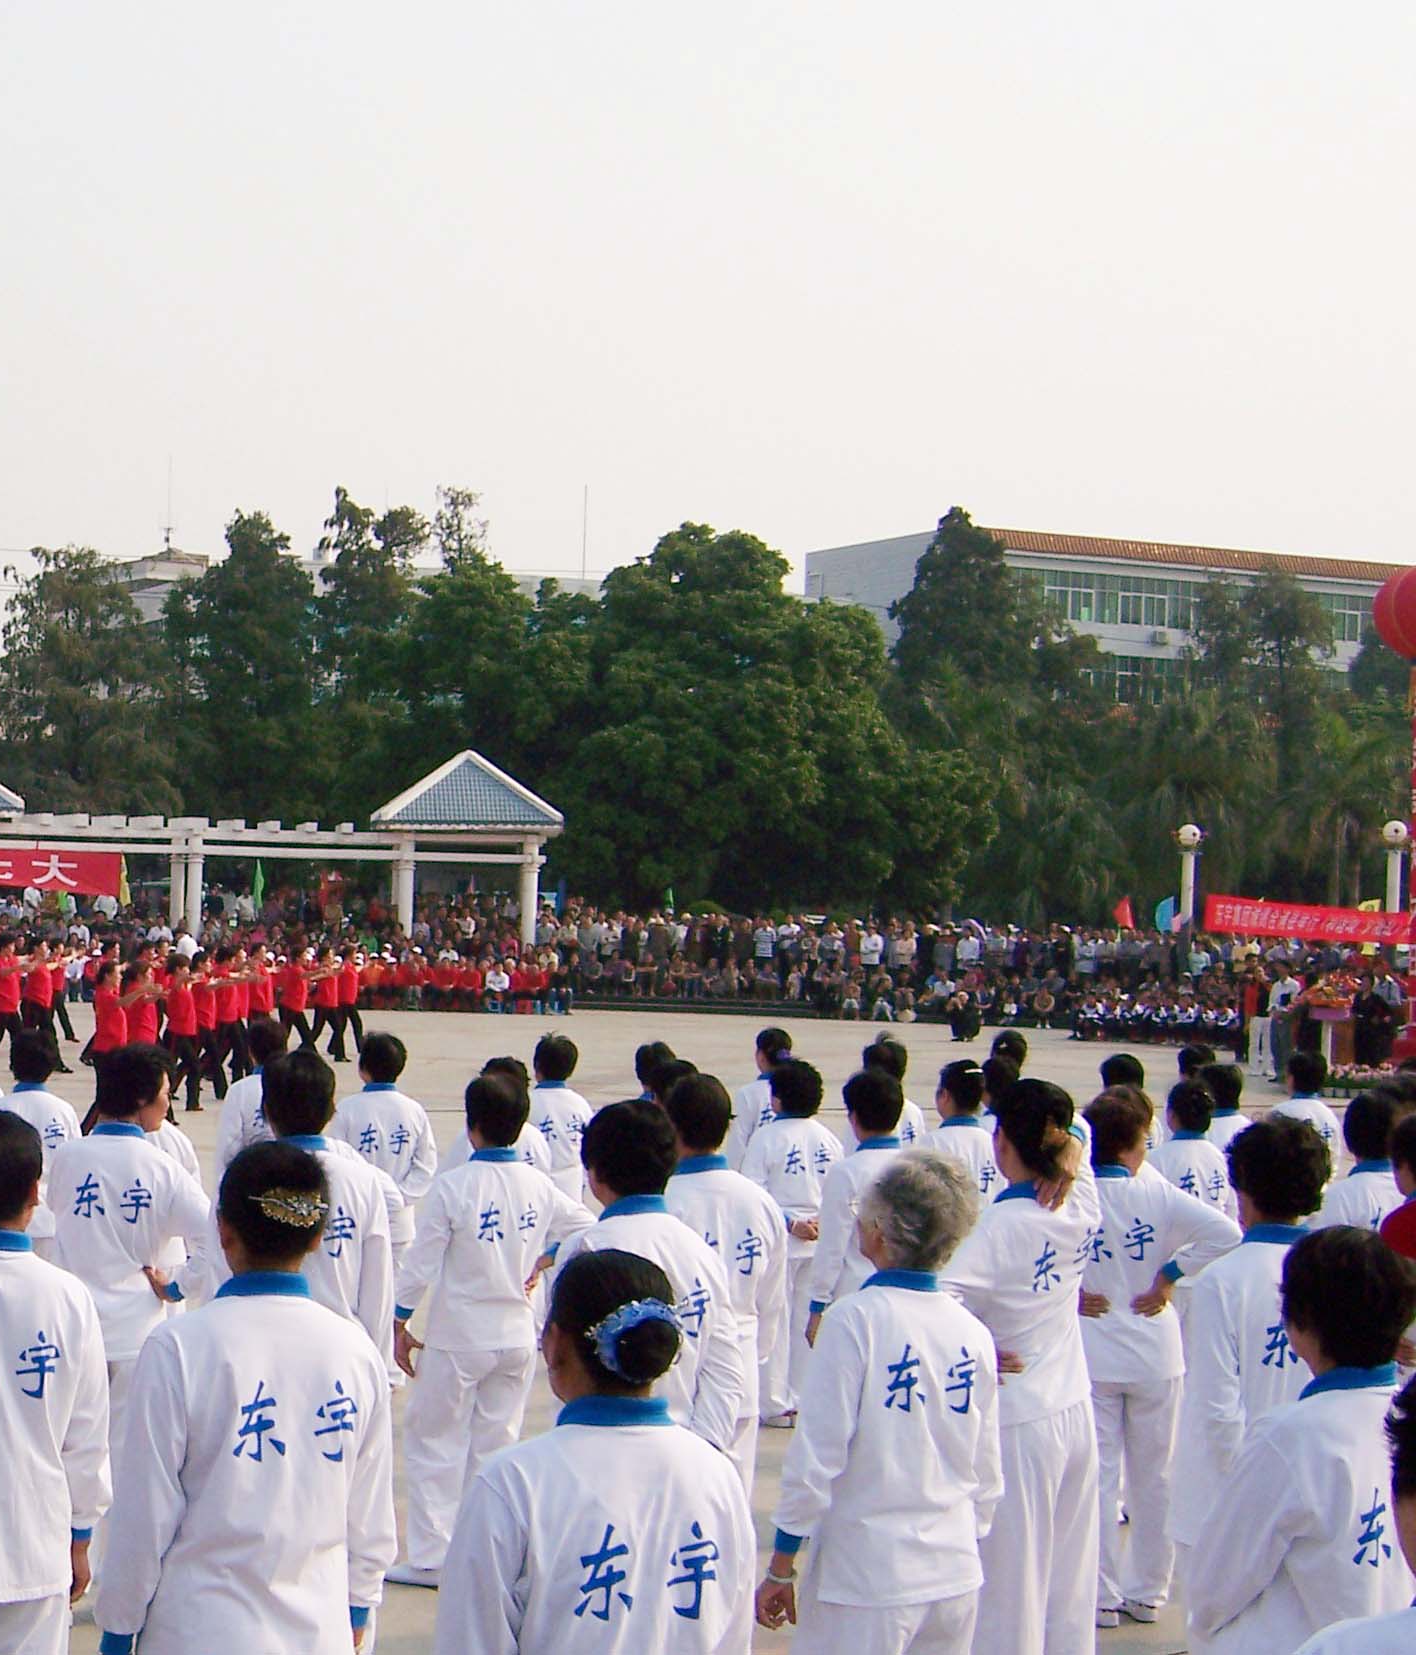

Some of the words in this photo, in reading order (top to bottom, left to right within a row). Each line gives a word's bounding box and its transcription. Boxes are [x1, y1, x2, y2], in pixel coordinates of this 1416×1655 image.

[44, 1118, 64, 1149] 宇
[359, 1123, 411, 1154] 东宇
[784, 1144, 832, 1175] 东宇
[73, 1172, 153, 1225] 东宇
[979, 1160, 996, 1194] 宇
[1179, 1167, 1225, 1201] 东宇
[323, 1206, 356, 1259] 宇
[477, 1201, 538, 1242] 东宇
[680, 1277, 711, 1339] 宇
[884, 1343, 977, 1415] 东宇
[232, 1380, 358, 1463] 东宇
[1352, 1487, 1392, 1568] 东
[573, 1521, 720, 1622] 东宇
